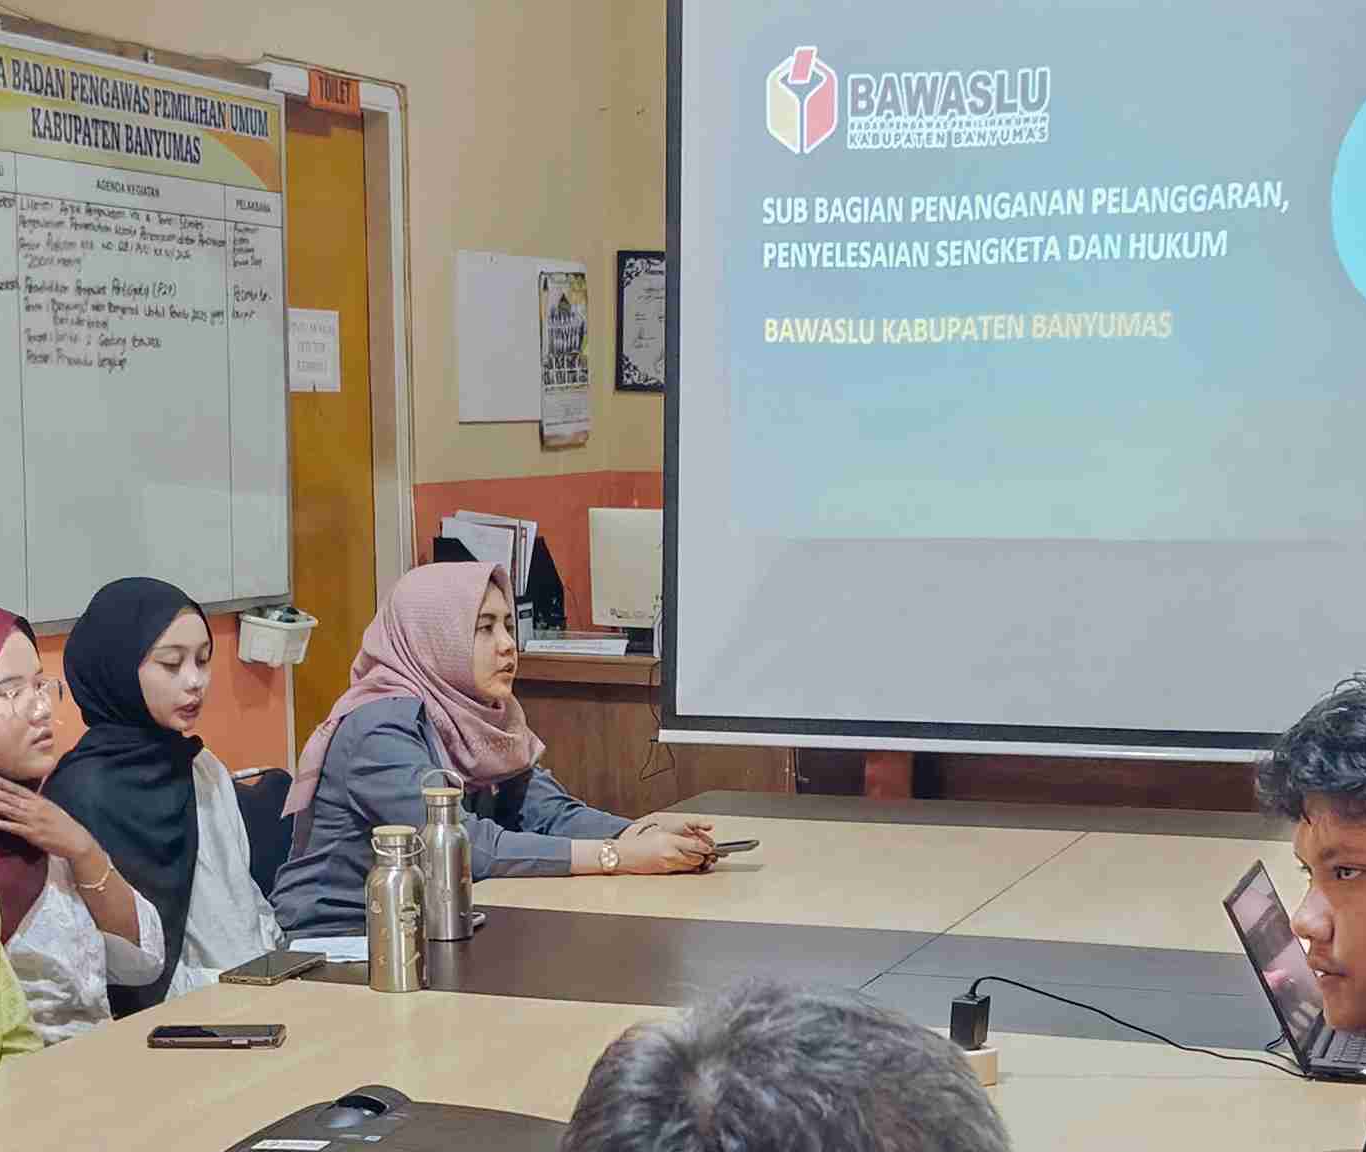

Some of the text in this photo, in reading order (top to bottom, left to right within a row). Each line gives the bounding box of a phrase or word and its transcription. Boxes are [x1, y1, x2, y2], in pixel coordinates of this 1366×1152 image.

[12, 58, 65, 100] BADAN
[71, 72, 150, 114] PENGAWAS
[153, 88, 226, 130] PEMILIHAN
[229, 103, 268, 137] UMUM
[319, 76, 351, 104] TOILET
[847, 68, 1050, 118] BAWASLU
[30, 106, 201, 165] KABUPATEN BANYUMAS
[848, 127, 1048, 148] KABUPATEN BANYUMAS
[762, 181, 1290, 225] SUB BAGIAN PENANGANAN PELANGGARAN,
[763, 230, 1228, 269] PENYELESAIAN SENGKETA DAN HUKUM
[764, 311, 1173, 345] BAWASLU KABUPATEN BANYUMAS
